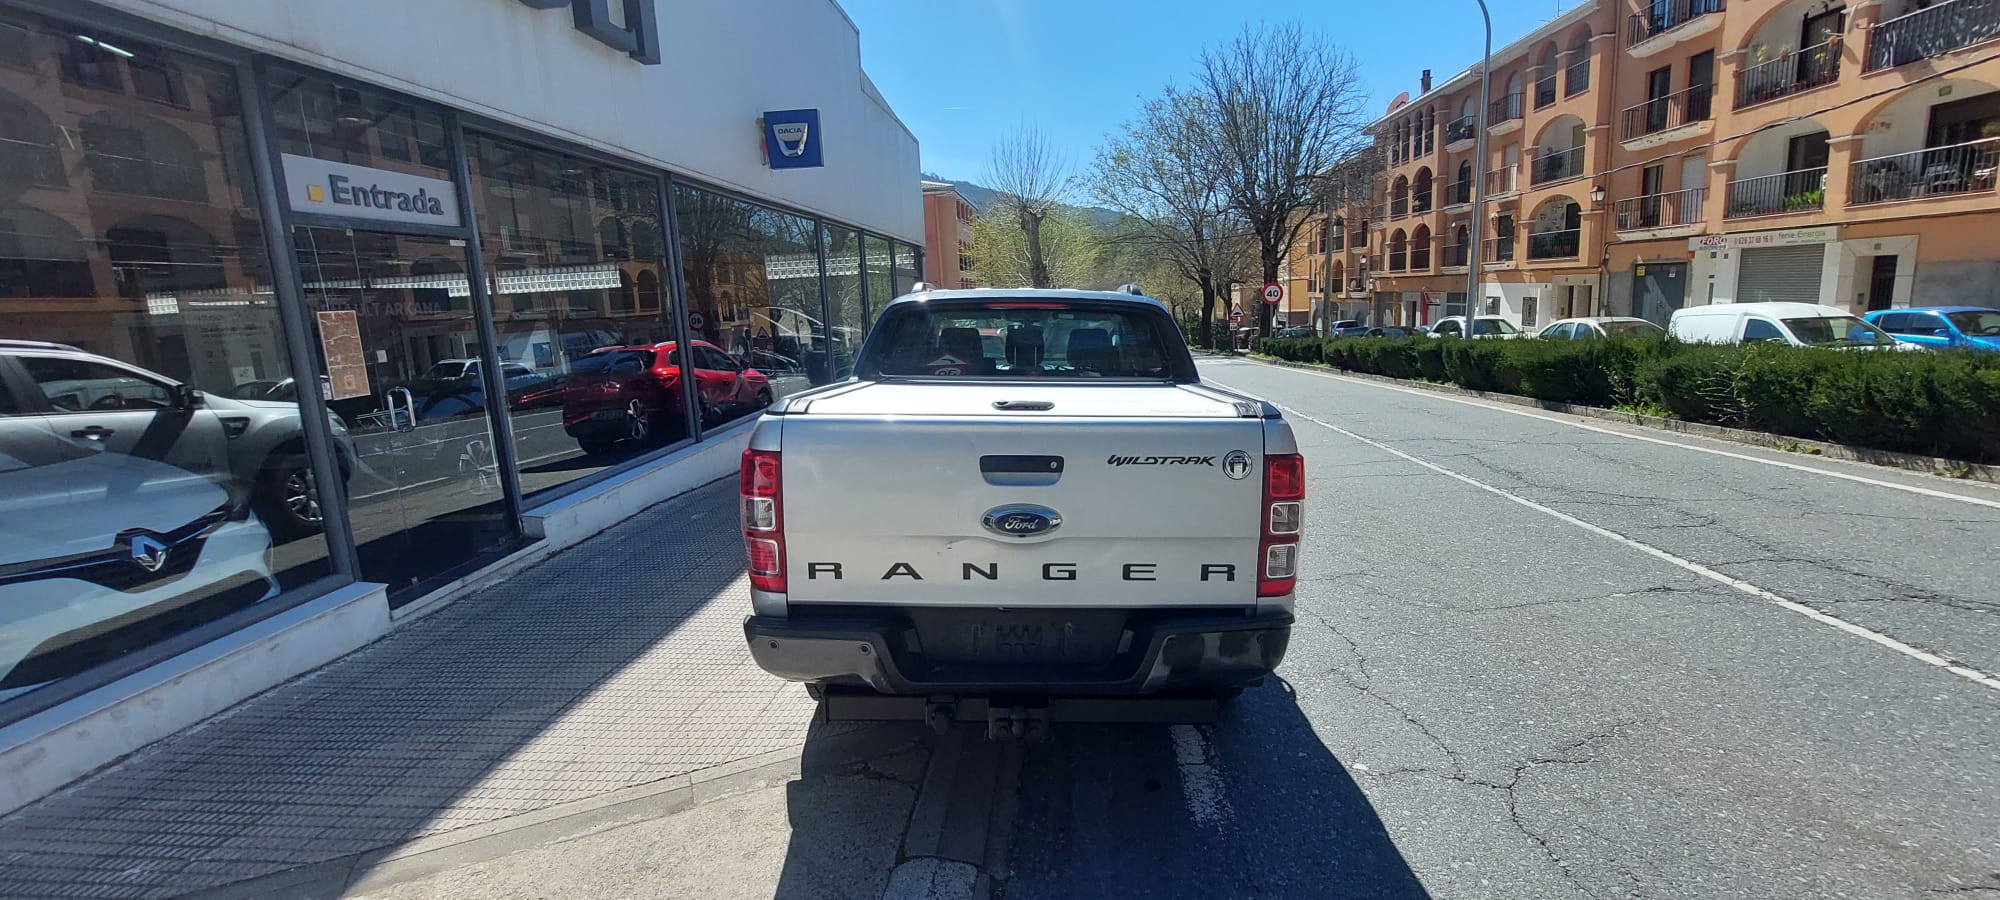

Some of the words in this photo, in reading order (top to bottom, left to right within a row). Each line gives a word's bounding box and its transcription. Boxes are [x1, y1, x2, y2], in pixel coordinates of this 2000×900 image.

[328, 173, 444, 216] Entrada
[1266, 289, 1279, 298] 40
[1106, 454, 1217, 467] WILDTRAK
[1004, 515, 1040, 530] Ford
[807, 562, 1236, 582] RANGER
